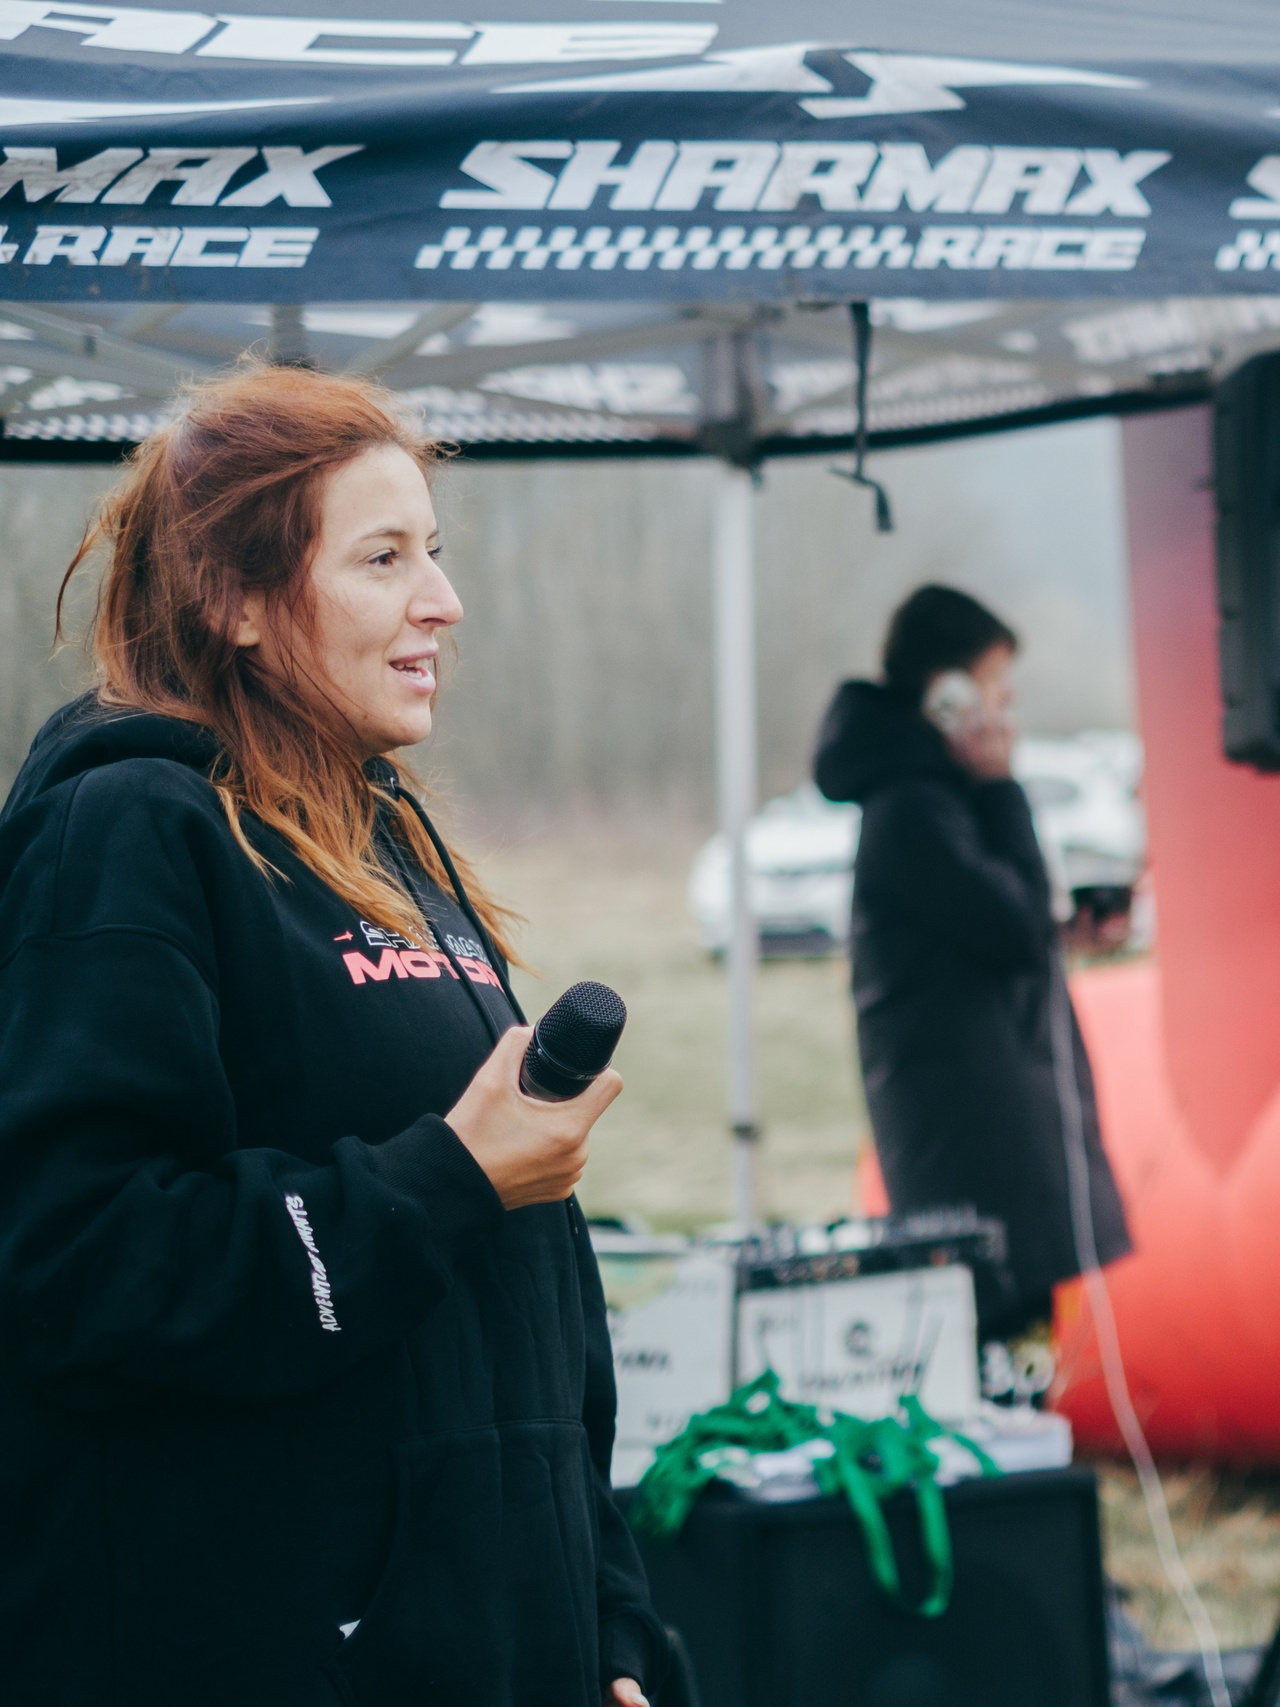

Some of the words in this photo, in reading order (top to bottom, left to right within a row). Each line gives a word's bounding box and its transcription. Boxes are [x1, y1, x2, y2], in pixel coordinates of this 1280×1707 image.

[439, 139, 1172, 219] SHARMAX
[23, 226, 320, 268] RACE
[912, 227, 1147, 271] RACE
